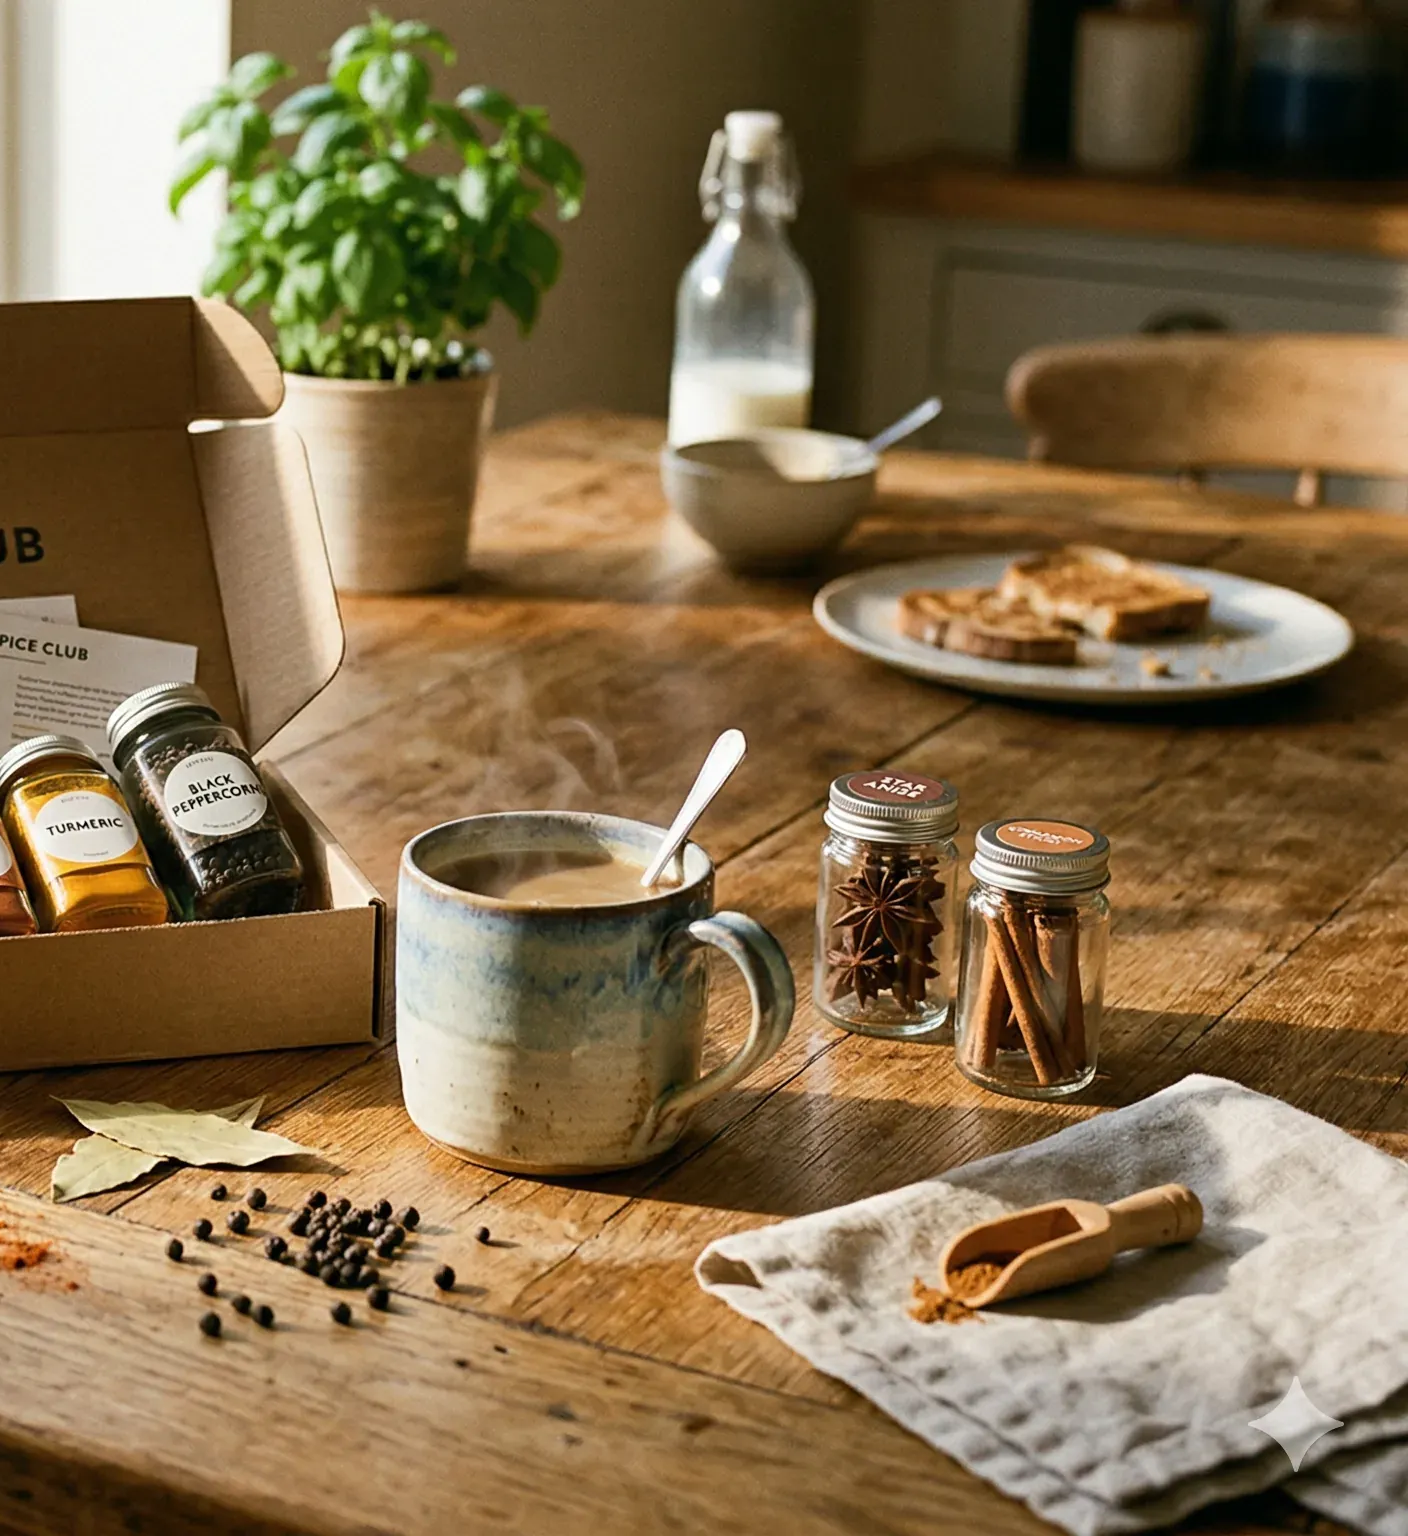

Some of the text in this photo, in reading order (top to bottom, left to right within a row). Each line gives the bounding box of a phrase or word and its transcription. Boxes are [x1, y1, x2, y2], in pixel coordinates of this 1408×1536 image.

[42, 642, 89, 661] CLUB
[188, 773, 235, 795] BLACK
[46, 818, 124, 836] TURMERIC
